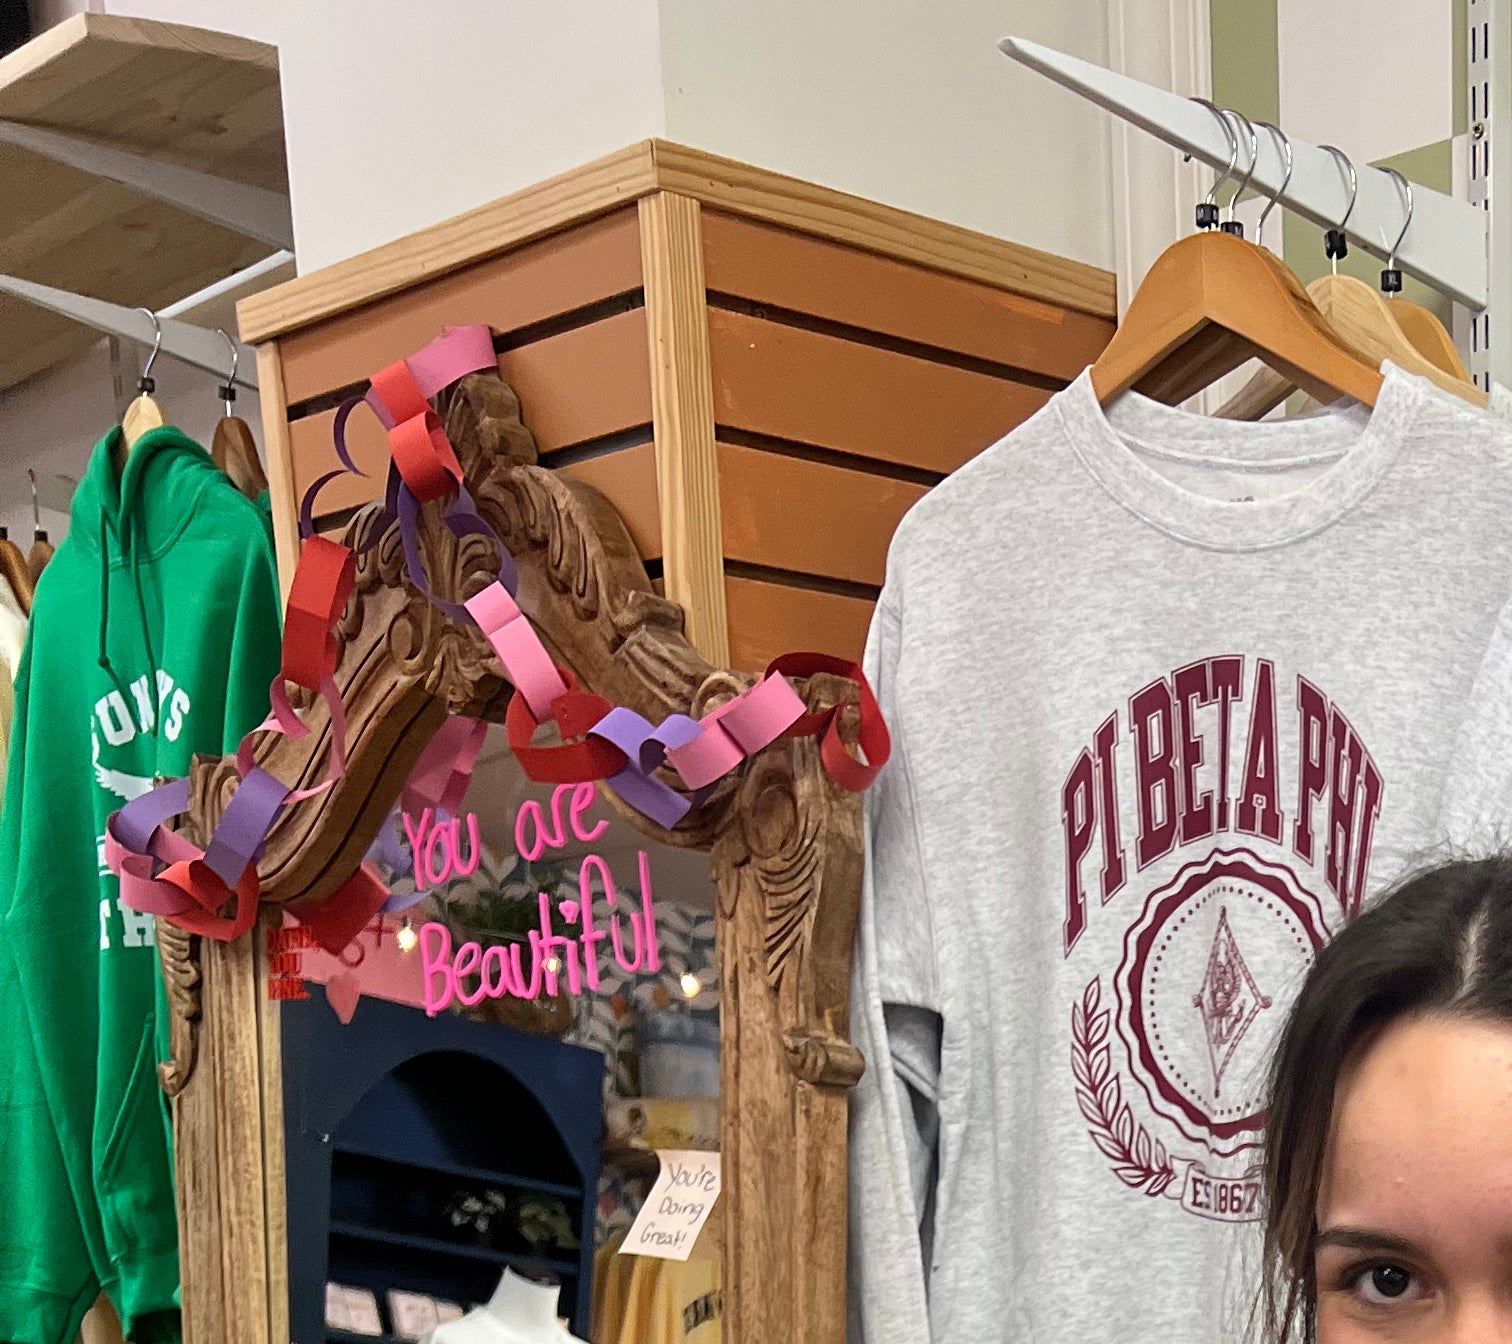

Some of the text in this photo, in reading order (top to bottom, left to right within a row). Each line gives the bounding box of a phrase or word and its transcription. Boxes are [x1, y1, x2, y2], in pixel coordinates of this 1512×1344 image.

[403, 782, 609, 890] You are
[1061, 653, 1385, 959] PI BETA PHI
[420, 850, 660, 1018] Beautiful
[658, 1196, 704, 1226] Doing
[664, 1163, 716, 1193] You're
[640, 1222, 688, 1250] Great!
